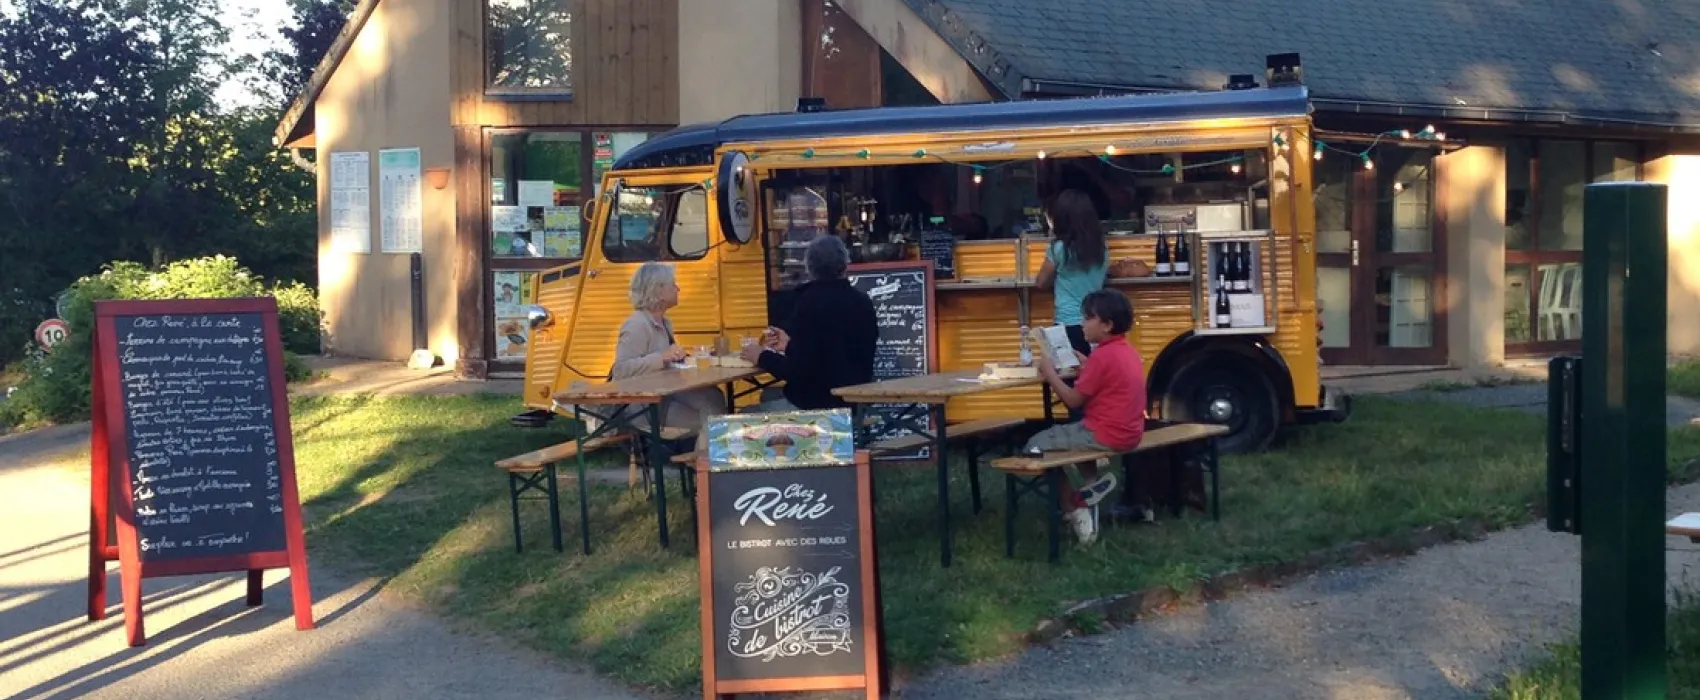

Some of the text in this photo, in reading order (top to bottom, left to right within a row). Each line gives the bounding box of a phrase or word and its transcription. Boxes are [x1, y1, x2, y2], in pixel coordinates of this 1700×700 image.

[133, 316, 158, 328] Chez
[200, 315, 212, 327] la
[215, 316, 242, 329] carte
[45, 330, 63, 342] 10
[156, 334, 166, 345] de
[784, 483, 814, 502] Chez
[734, 487, 834, 527] René
[727, 536, 847, 549] LE BISTROT AVEC DES ROUES
[754, 586, 803, 621] Cuisine
[744, 595, 833, 653] de bistrot
